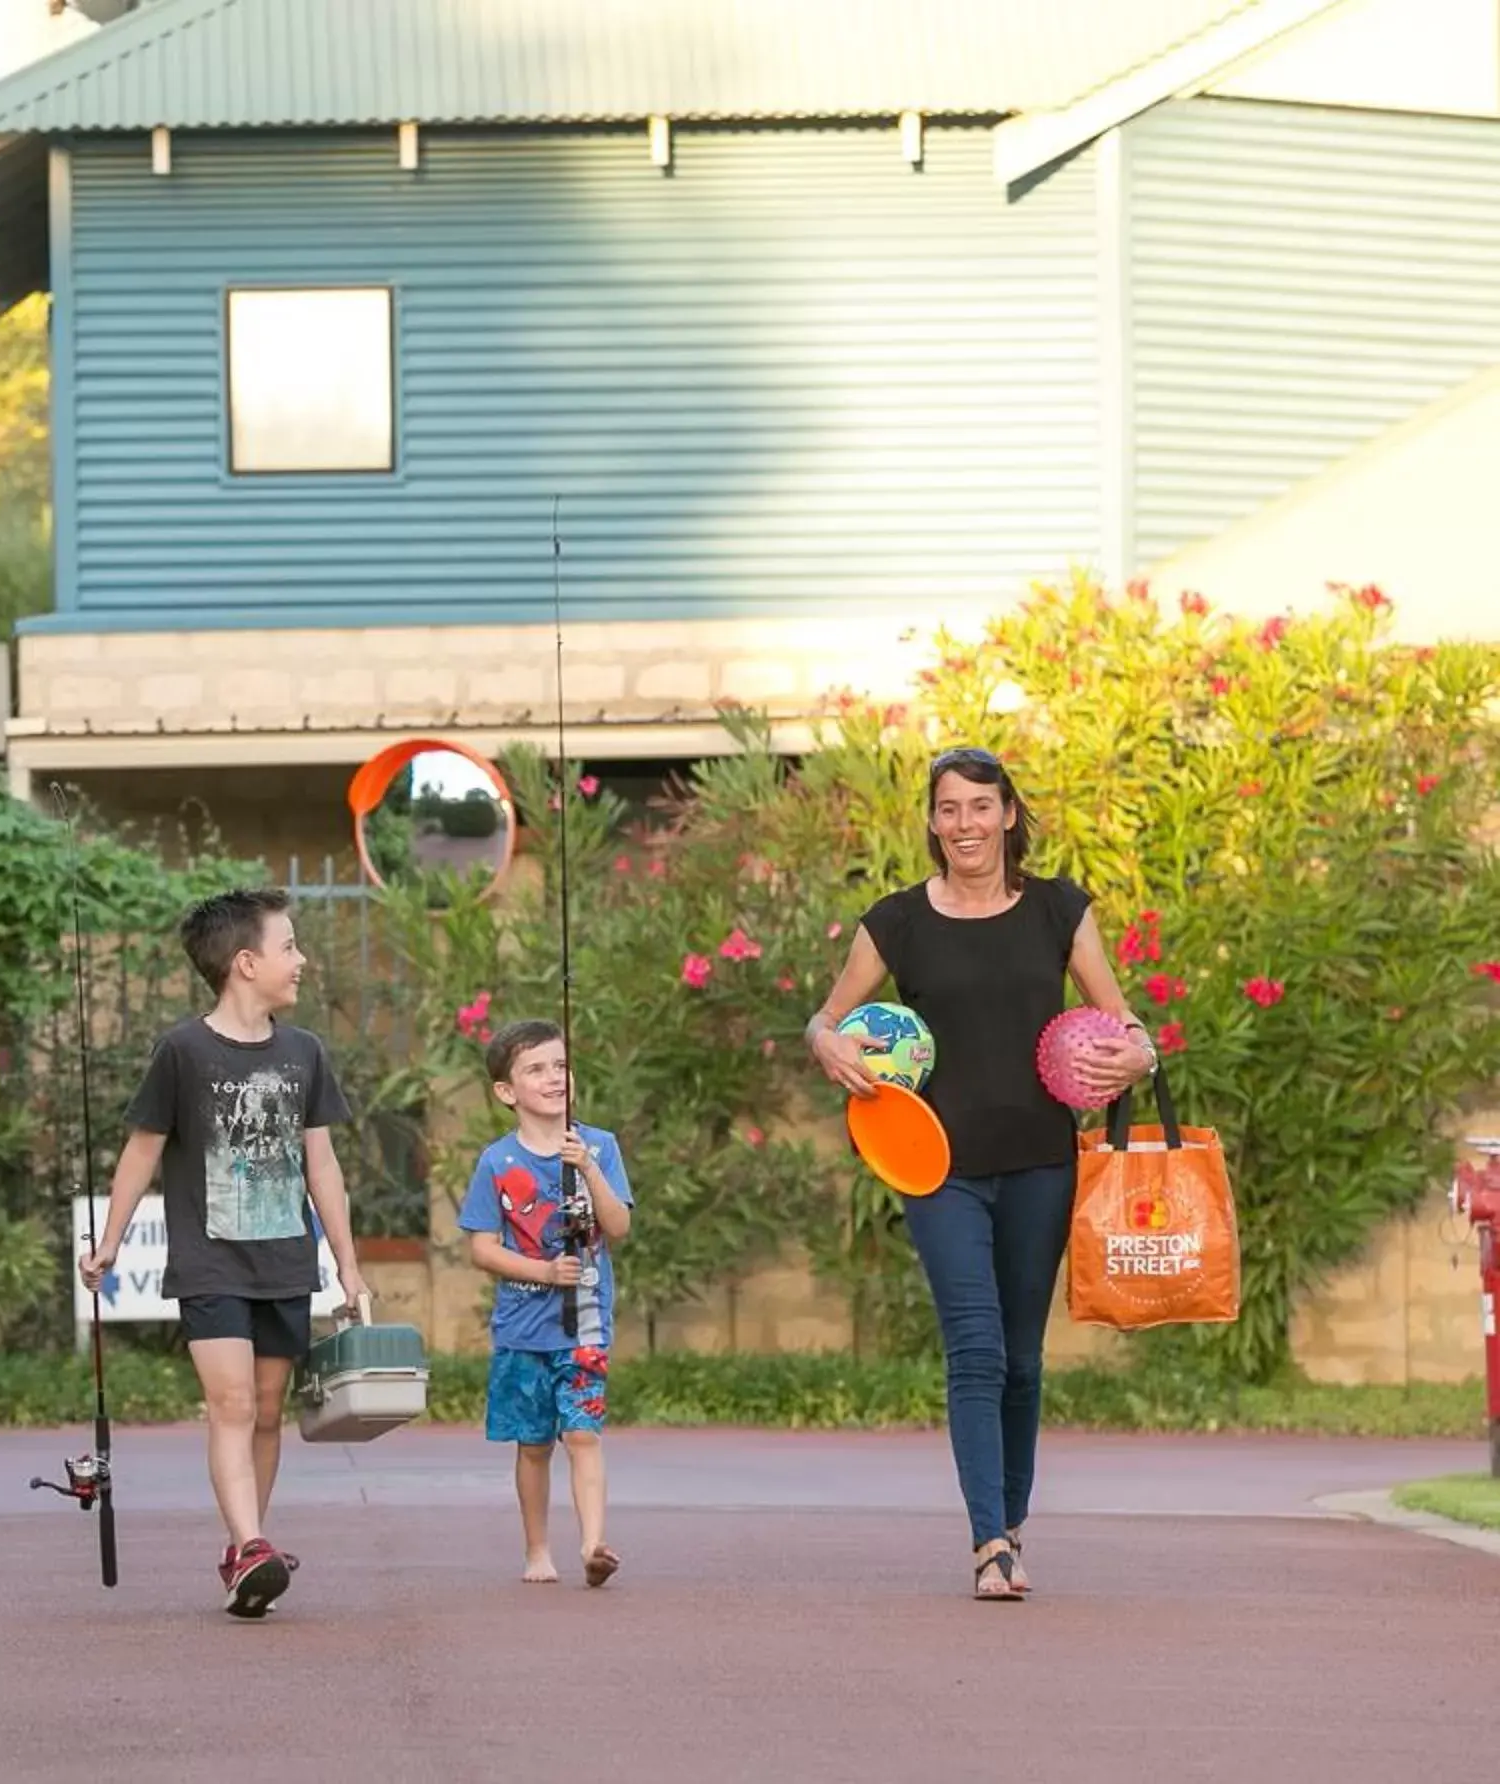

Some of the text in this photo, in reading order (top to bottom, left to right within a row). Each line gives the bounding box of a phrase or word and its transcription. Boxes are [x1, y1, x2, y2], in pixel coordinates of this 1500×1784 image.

[274, 1112, 300, 1126] THE
[1106, 1233, 1202, 1256] PRESTON
[1107, 1255, 1182, 1276] STREET
